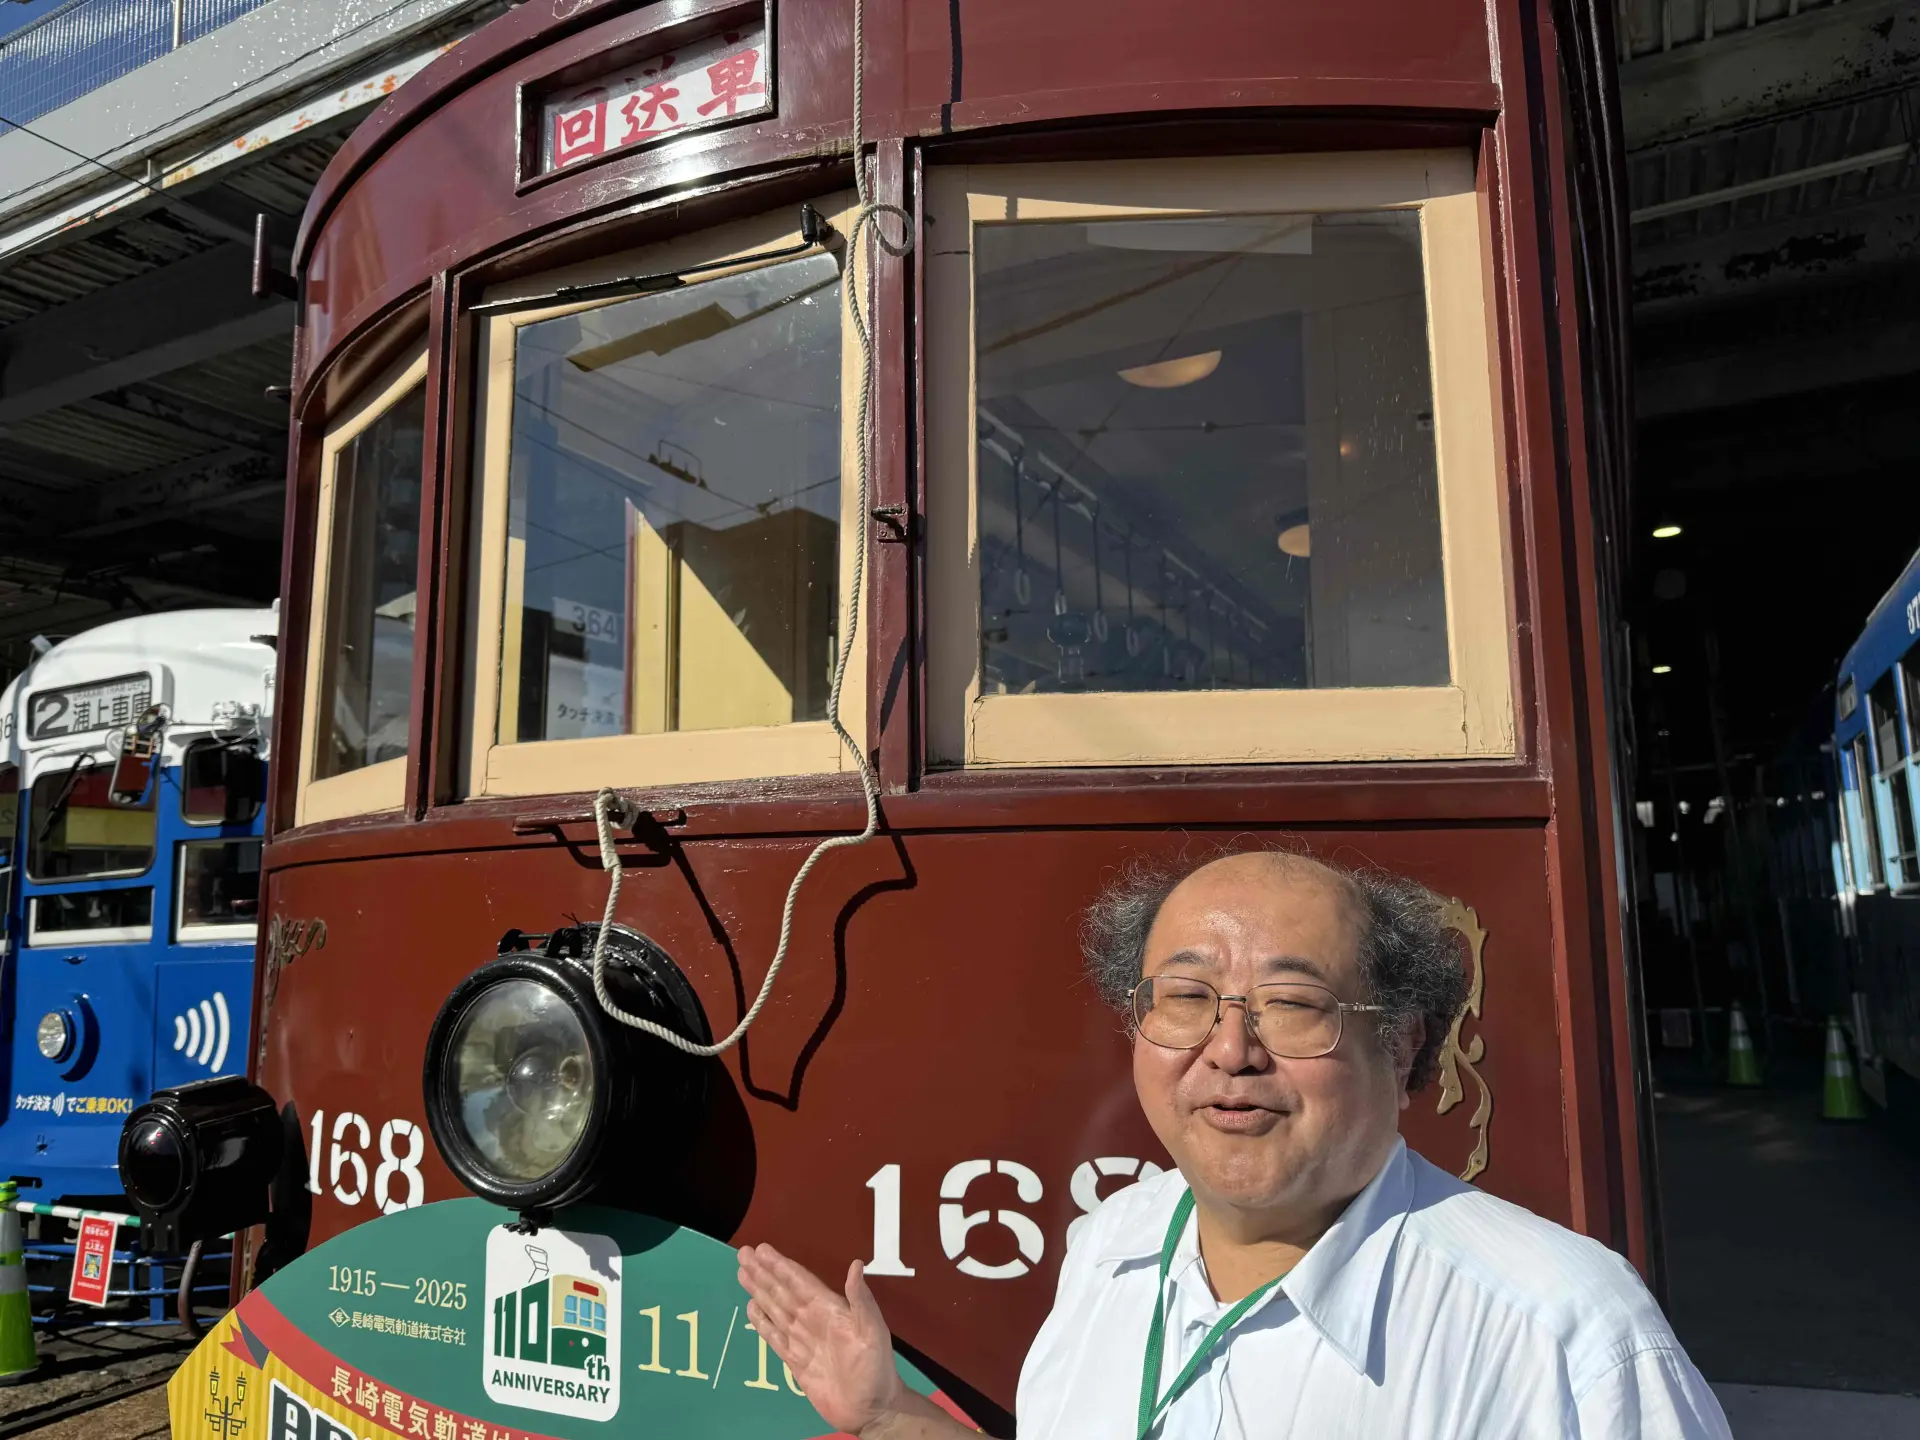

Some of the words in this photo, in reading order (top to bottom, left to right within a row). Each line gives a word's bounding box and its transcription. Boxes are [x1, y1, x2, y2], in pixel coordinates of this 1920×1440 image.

[554, 32, 765, 169] 回送車
[572, 605, 616, 640] 364
[1906, 591, 1920, 635] 87
[37, 694, 69, 736] 2
[73, 691, 151, 732] 浦上車庫
[305, 1109, 425, 1216] 168
[350, 1311, 468, 1348] 長崎電気軌道株式会社
[330, 1365, 530, 1440] 長崎電気軌道
[491, 1368, 611, 1404] ANNIVERSARY
